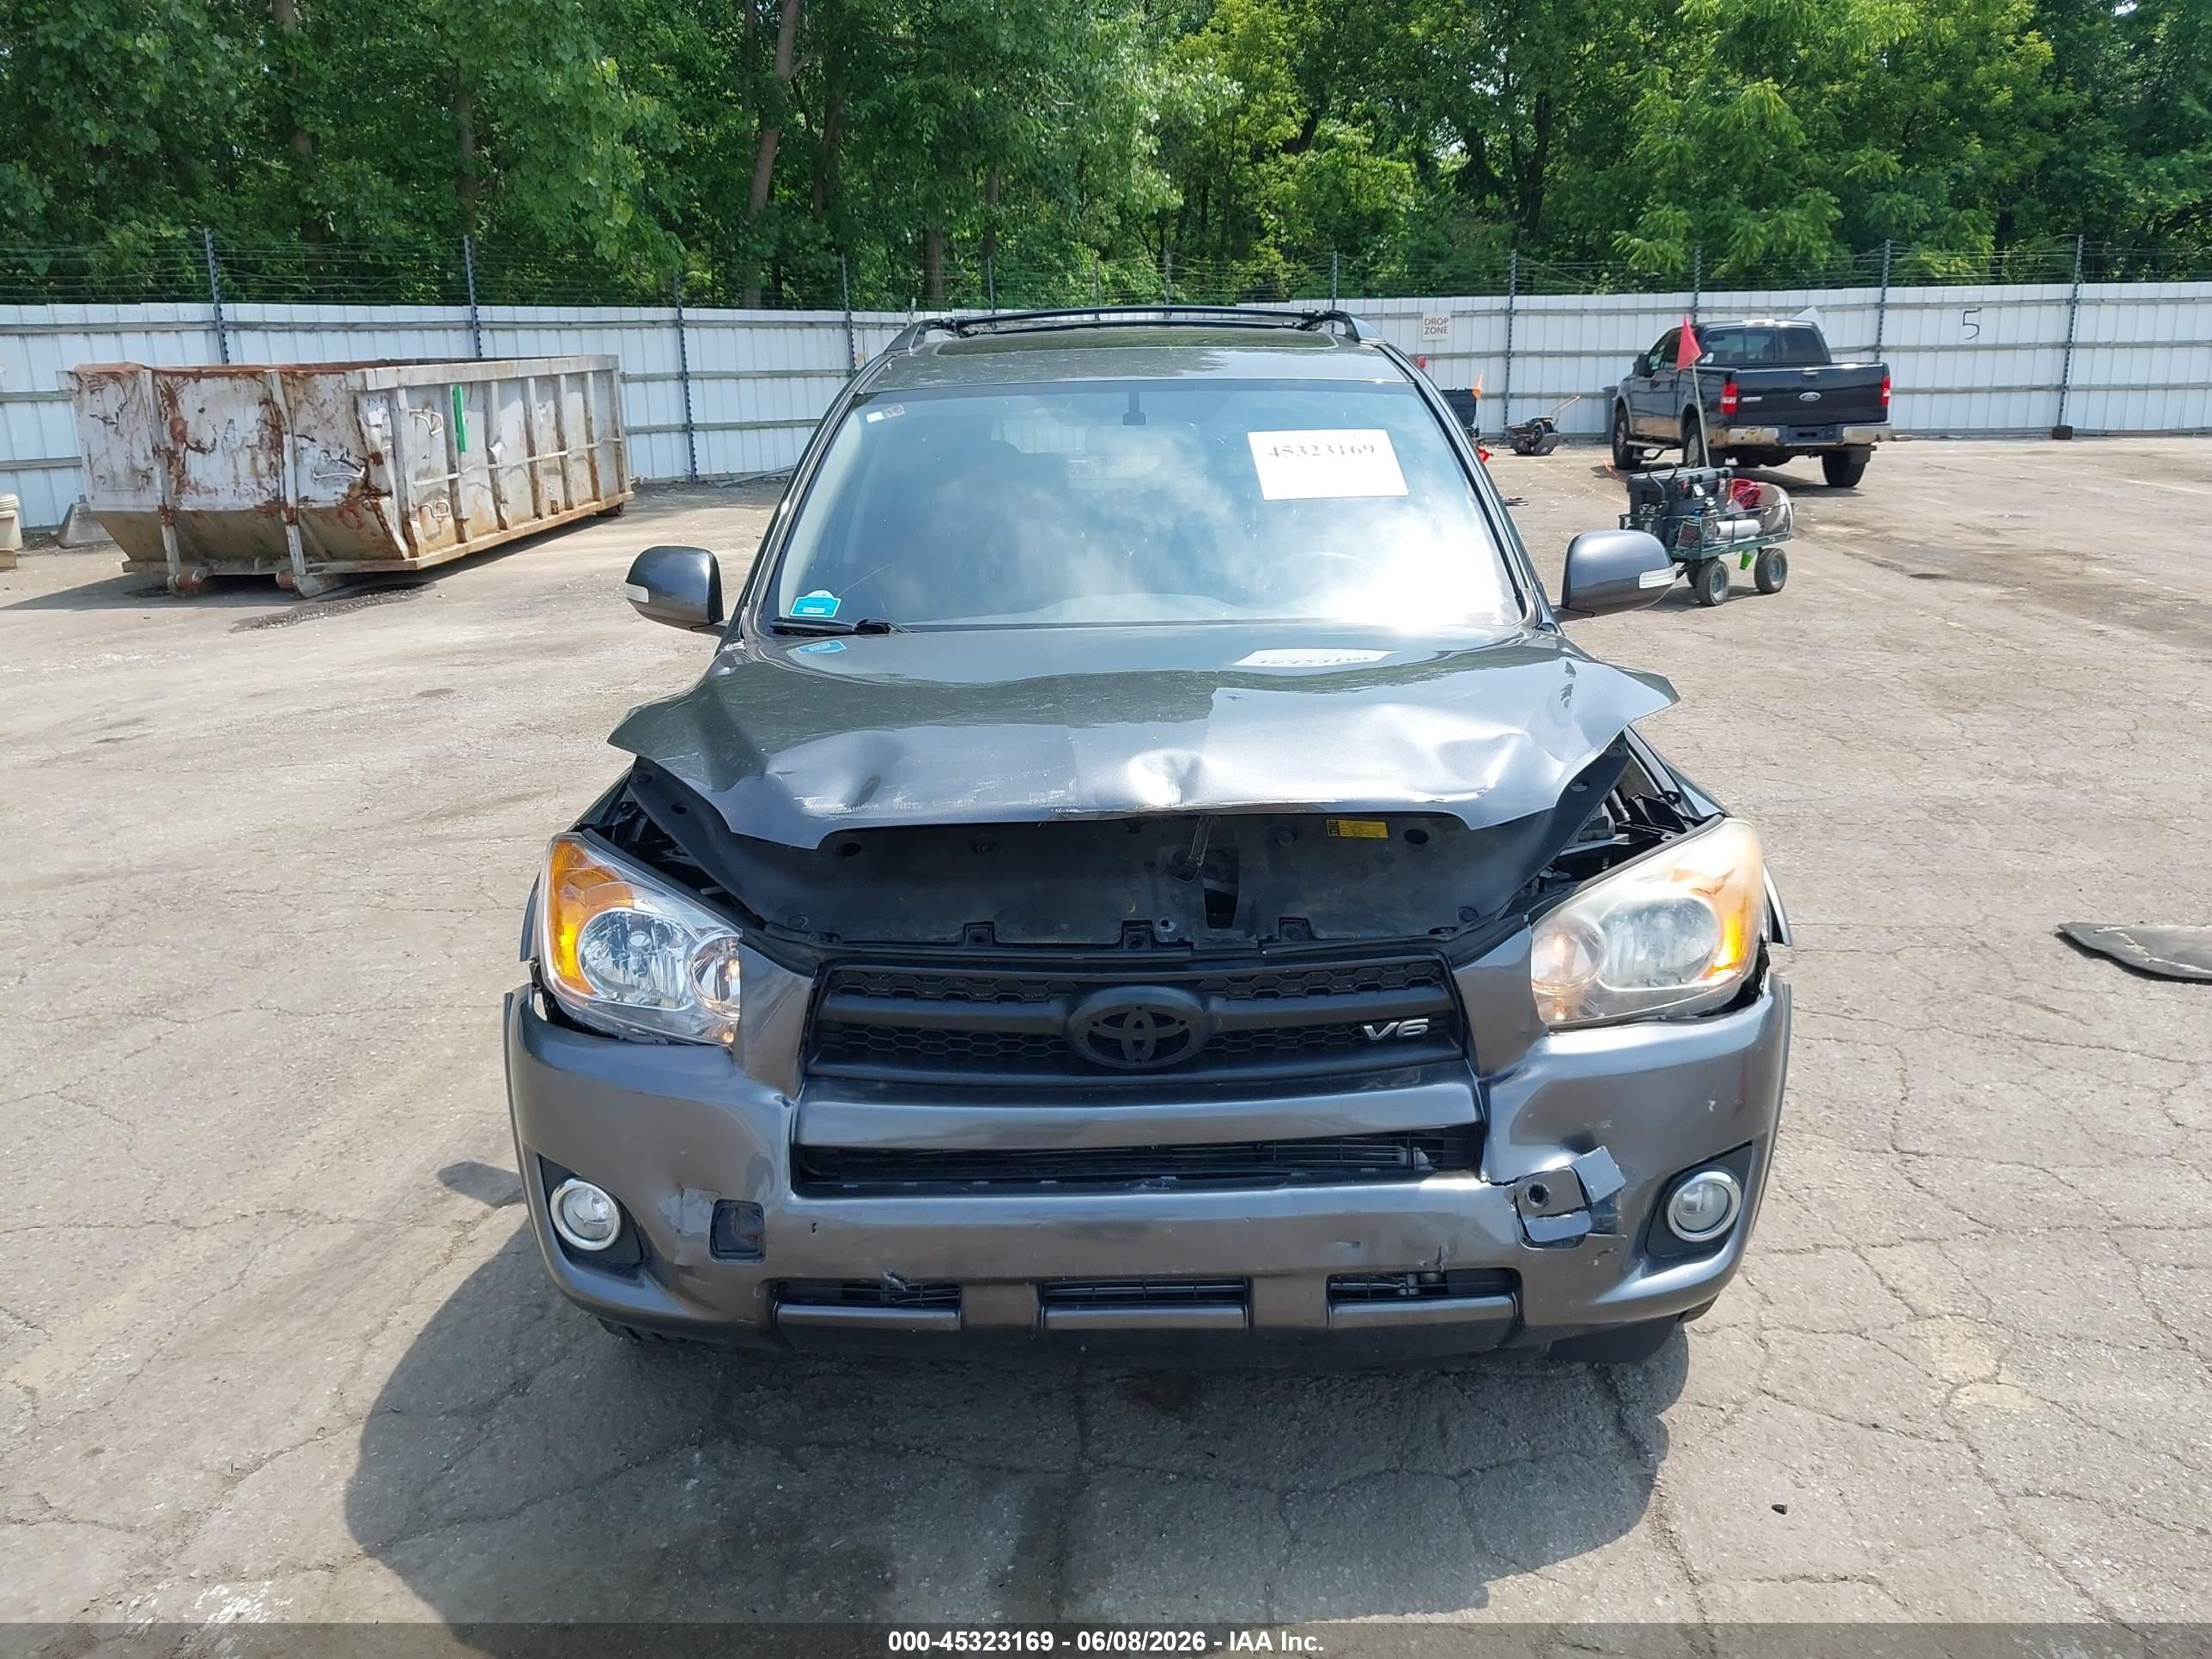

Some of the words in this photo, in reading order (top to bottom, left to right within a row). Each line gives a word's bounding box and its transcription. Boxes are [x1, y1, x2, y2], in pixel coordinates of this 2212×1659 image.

[1424, 317, 1449, 326] DROP
[1962, 307, 1982, 340] 5
[1424, 325, 1449, 335] ZONE
[1268, 443, 1375, 458] 45323169
[1363, 1018, 1430, 1041] V6
